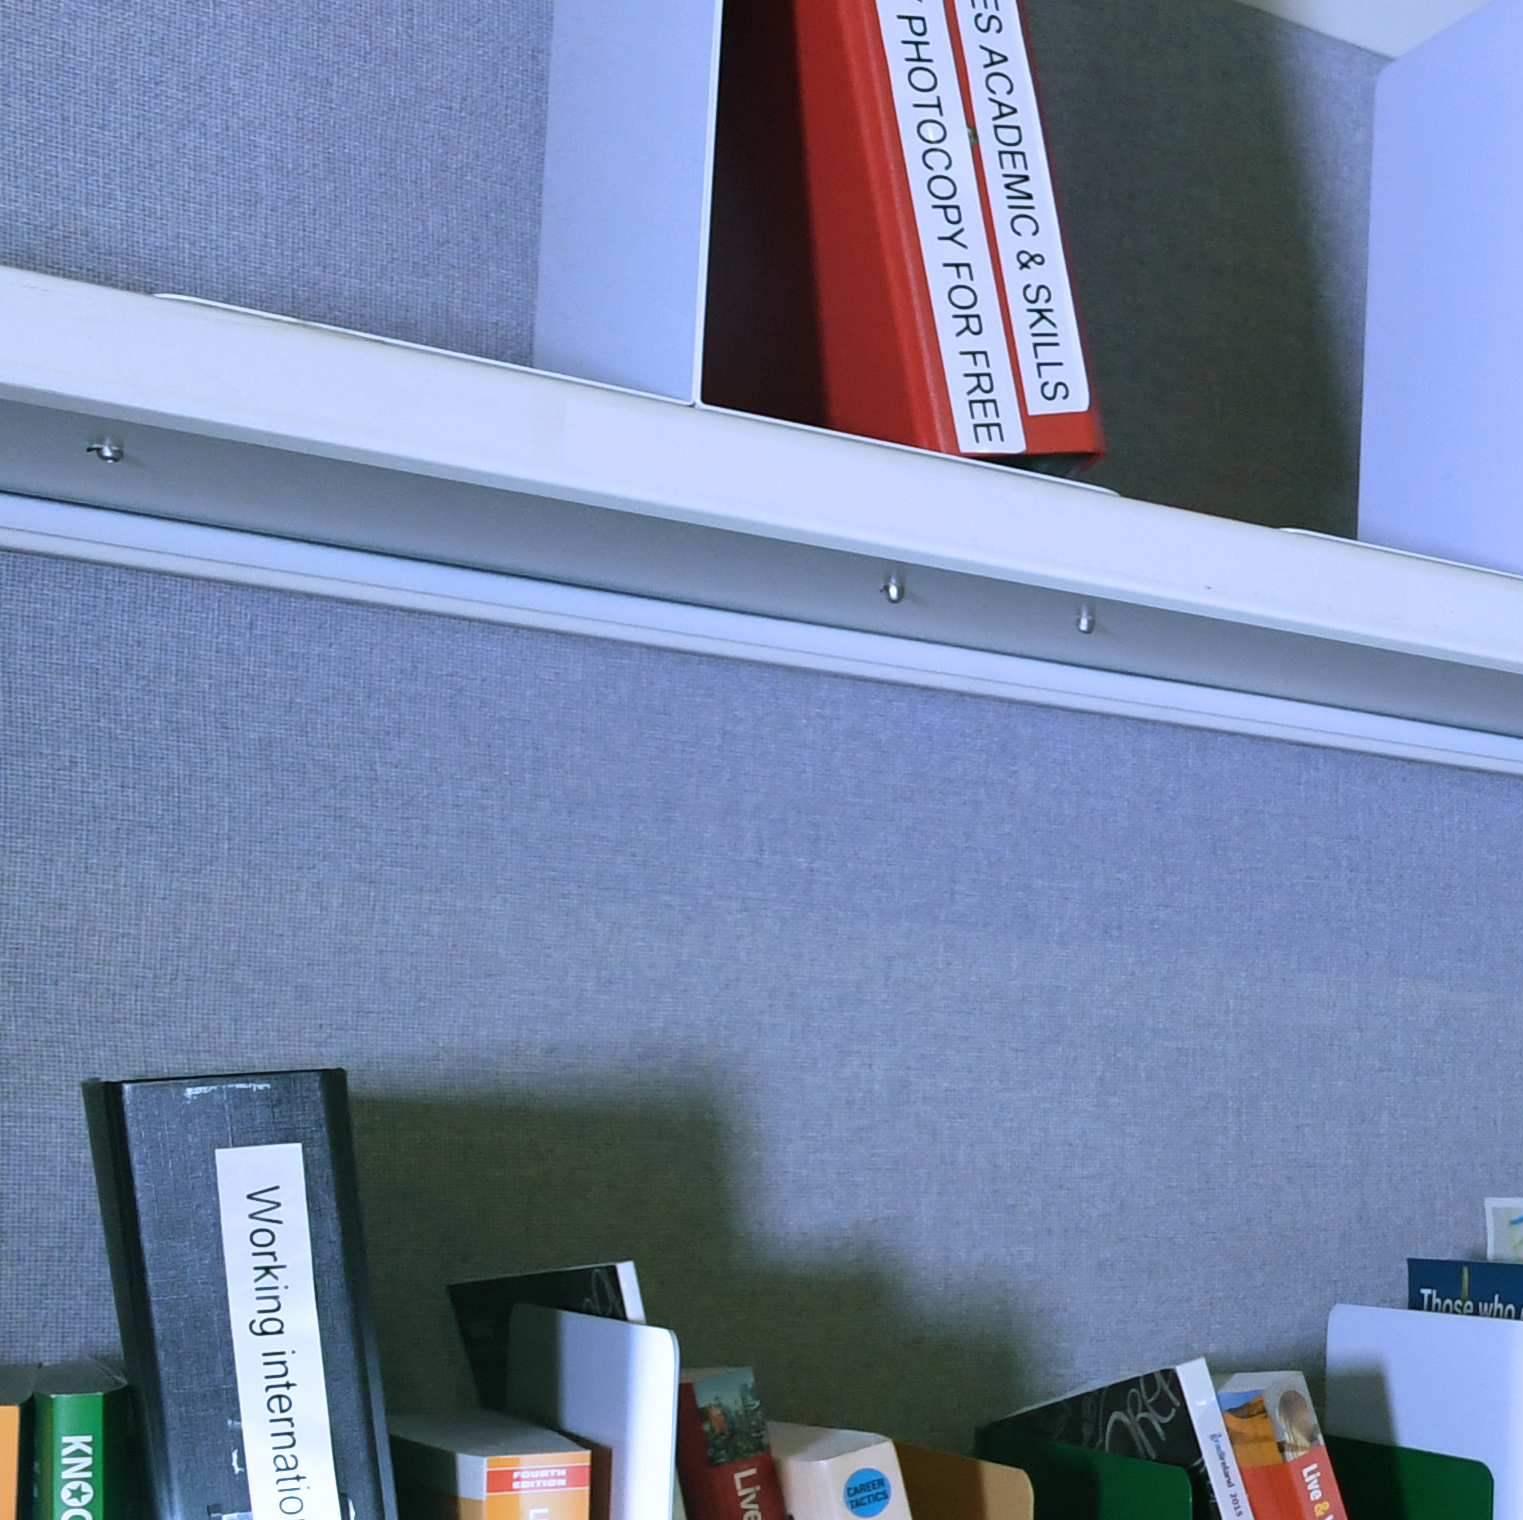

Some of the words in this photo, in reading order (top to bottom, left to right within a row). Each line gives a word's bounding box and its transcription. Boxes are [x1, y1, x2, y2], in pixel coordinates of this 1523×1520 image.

[898, 15, 968, 249] PHOTOCOPY
[979, 46, 1039, 239] ACADEMIC
[942, 261, 983, 337] FOR
[1016, 249, 1045, 270] &
[1022, 283, 1069, 402] SKILLS
[958, 350, 1004, 444] FREE
[246, 1186, 283, 1337] Working
[846, 1477, 885, 1496] CAREER
[850, 1491, 888, 1509] TACTICS
[1302, 1463, 1322, 1502] Live
[1314, 1501, 1330, 1518] &
